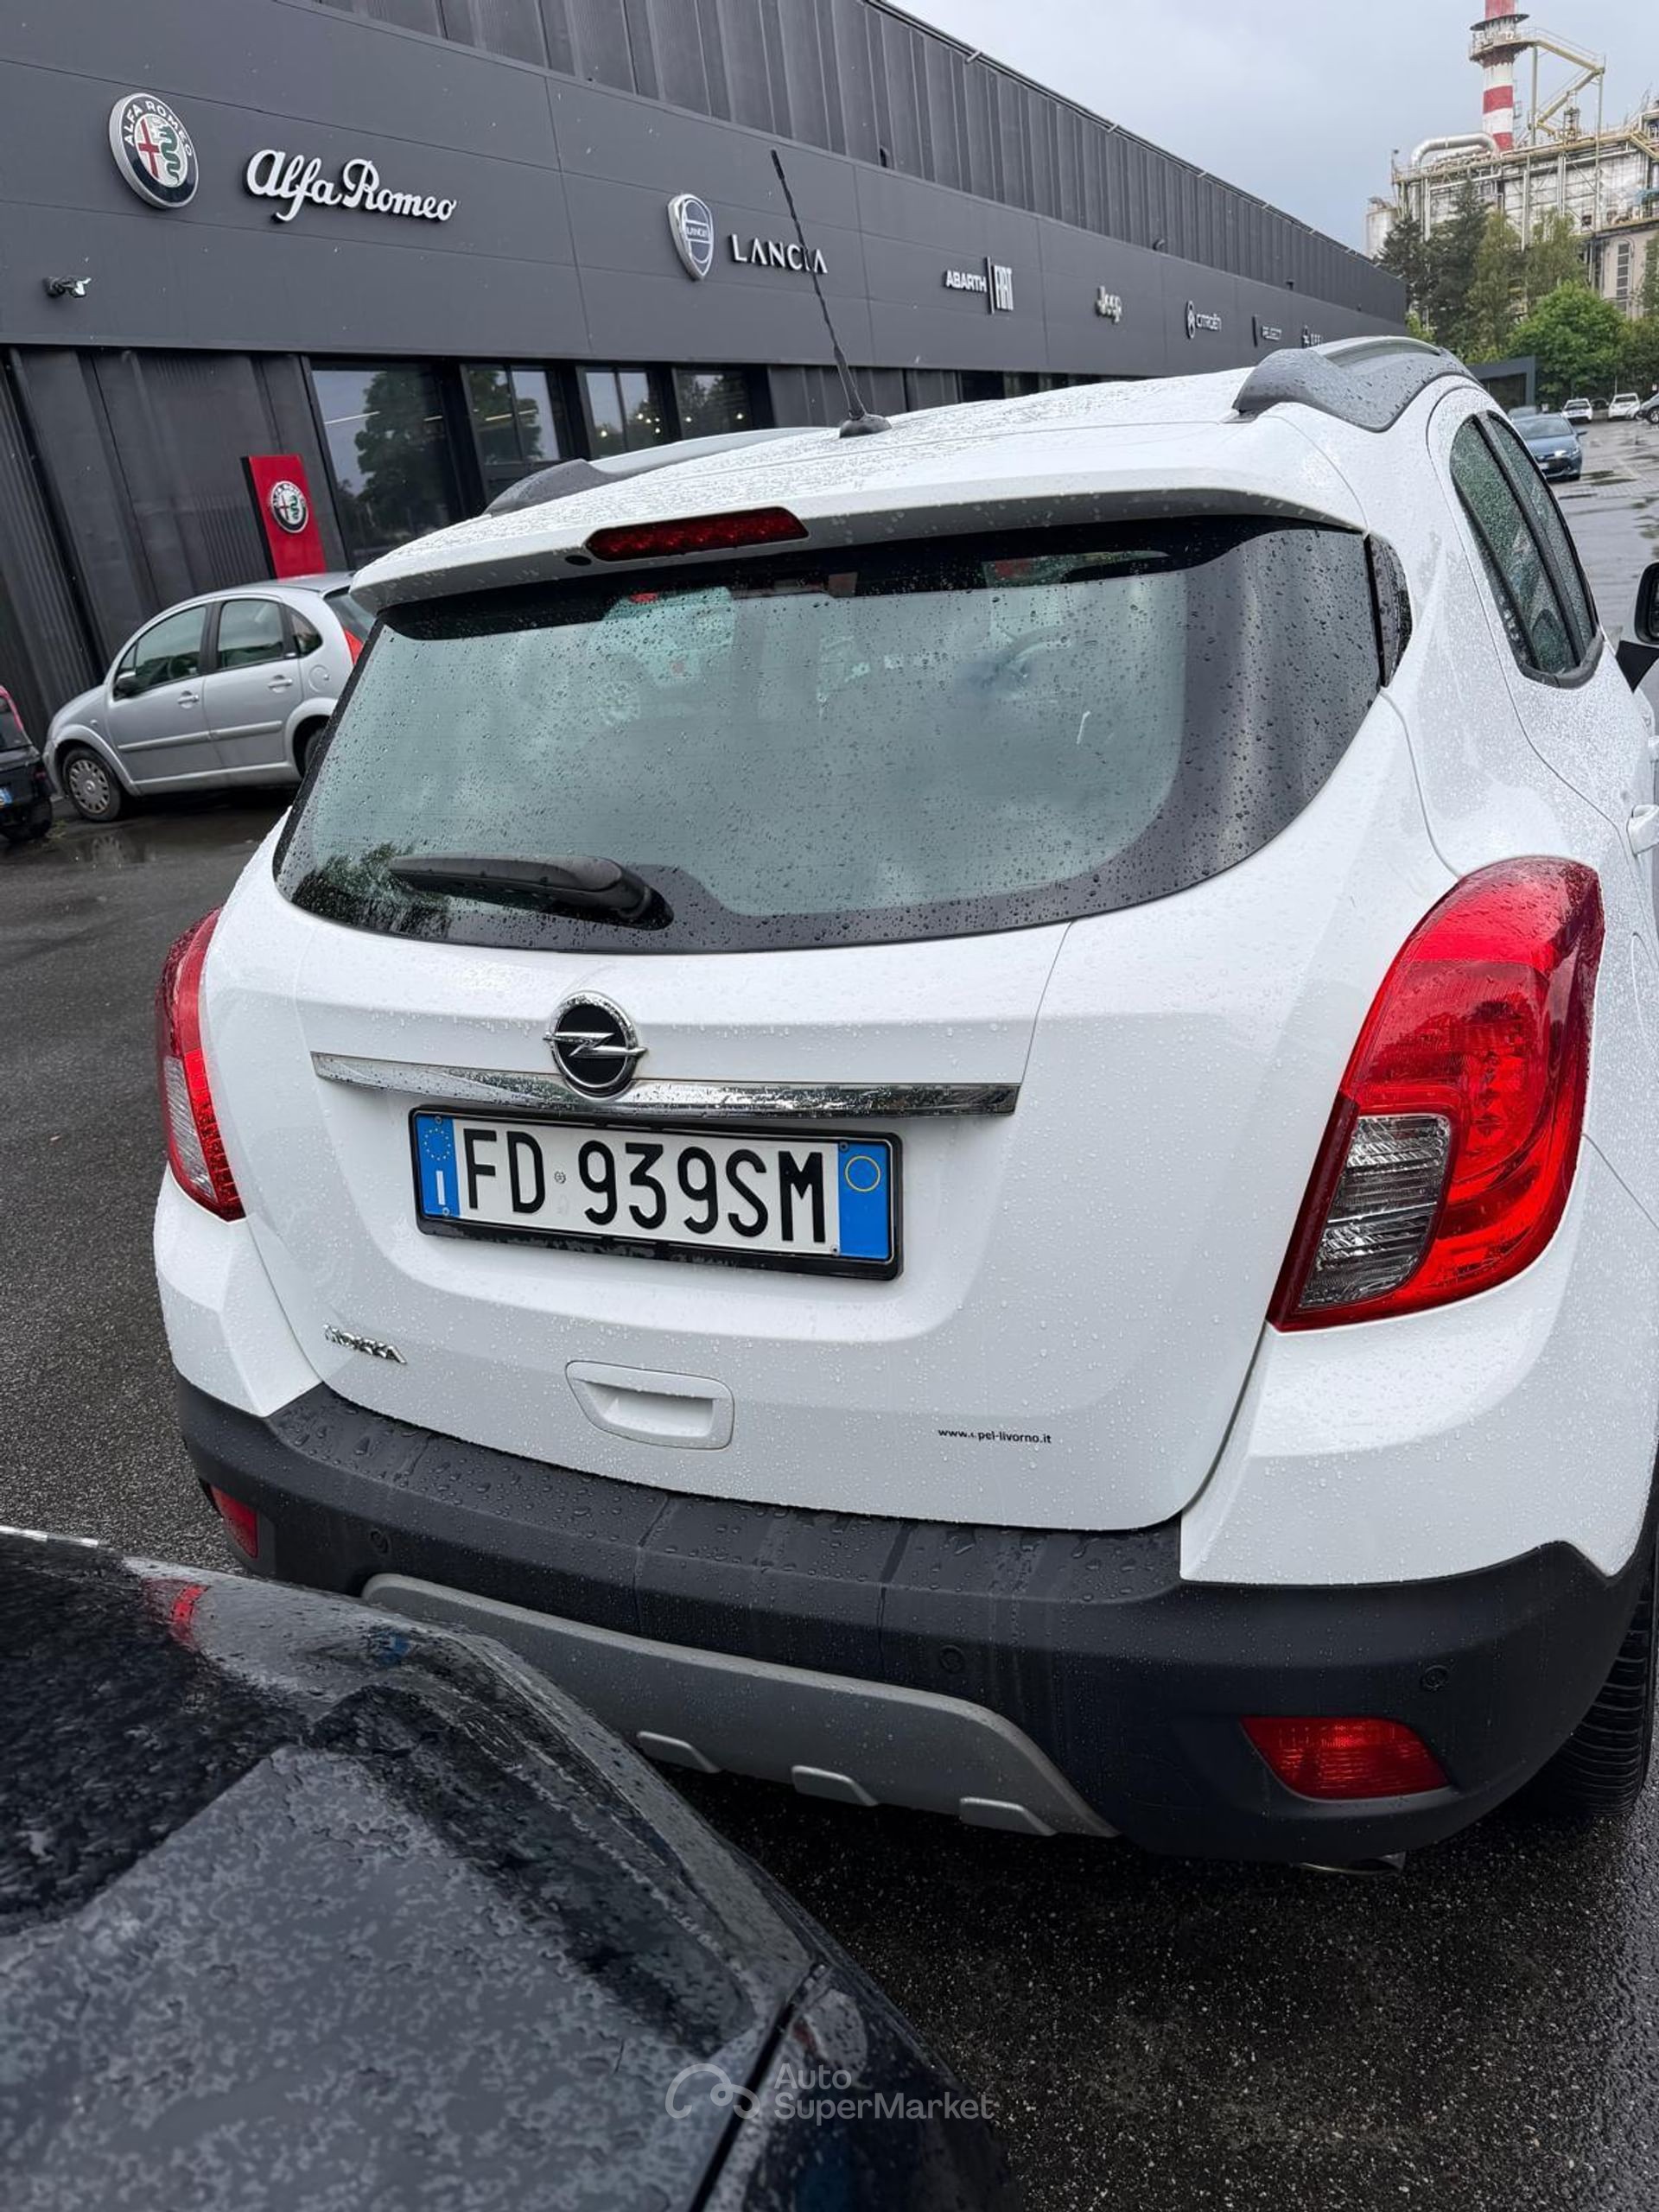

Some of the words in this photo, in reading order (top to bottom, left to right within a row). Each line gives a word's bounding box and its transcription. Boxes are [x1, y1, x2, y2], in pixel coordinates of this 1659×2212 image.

[124, 104, 143, 147] ALFA
[145, 100, 193, 156] ROMEO
[246, 149, 343, 221] Alfa
[343, 158, 456, 221] Romeo
[731, 233, 829, 275] LANCIA
[946, 270, 988, 293] ABARTH
[994, 264, 1014, 311] FIAT
[462, 1127, 546, 1214] FD
[577, 1139, 827, 1243] 939SM
